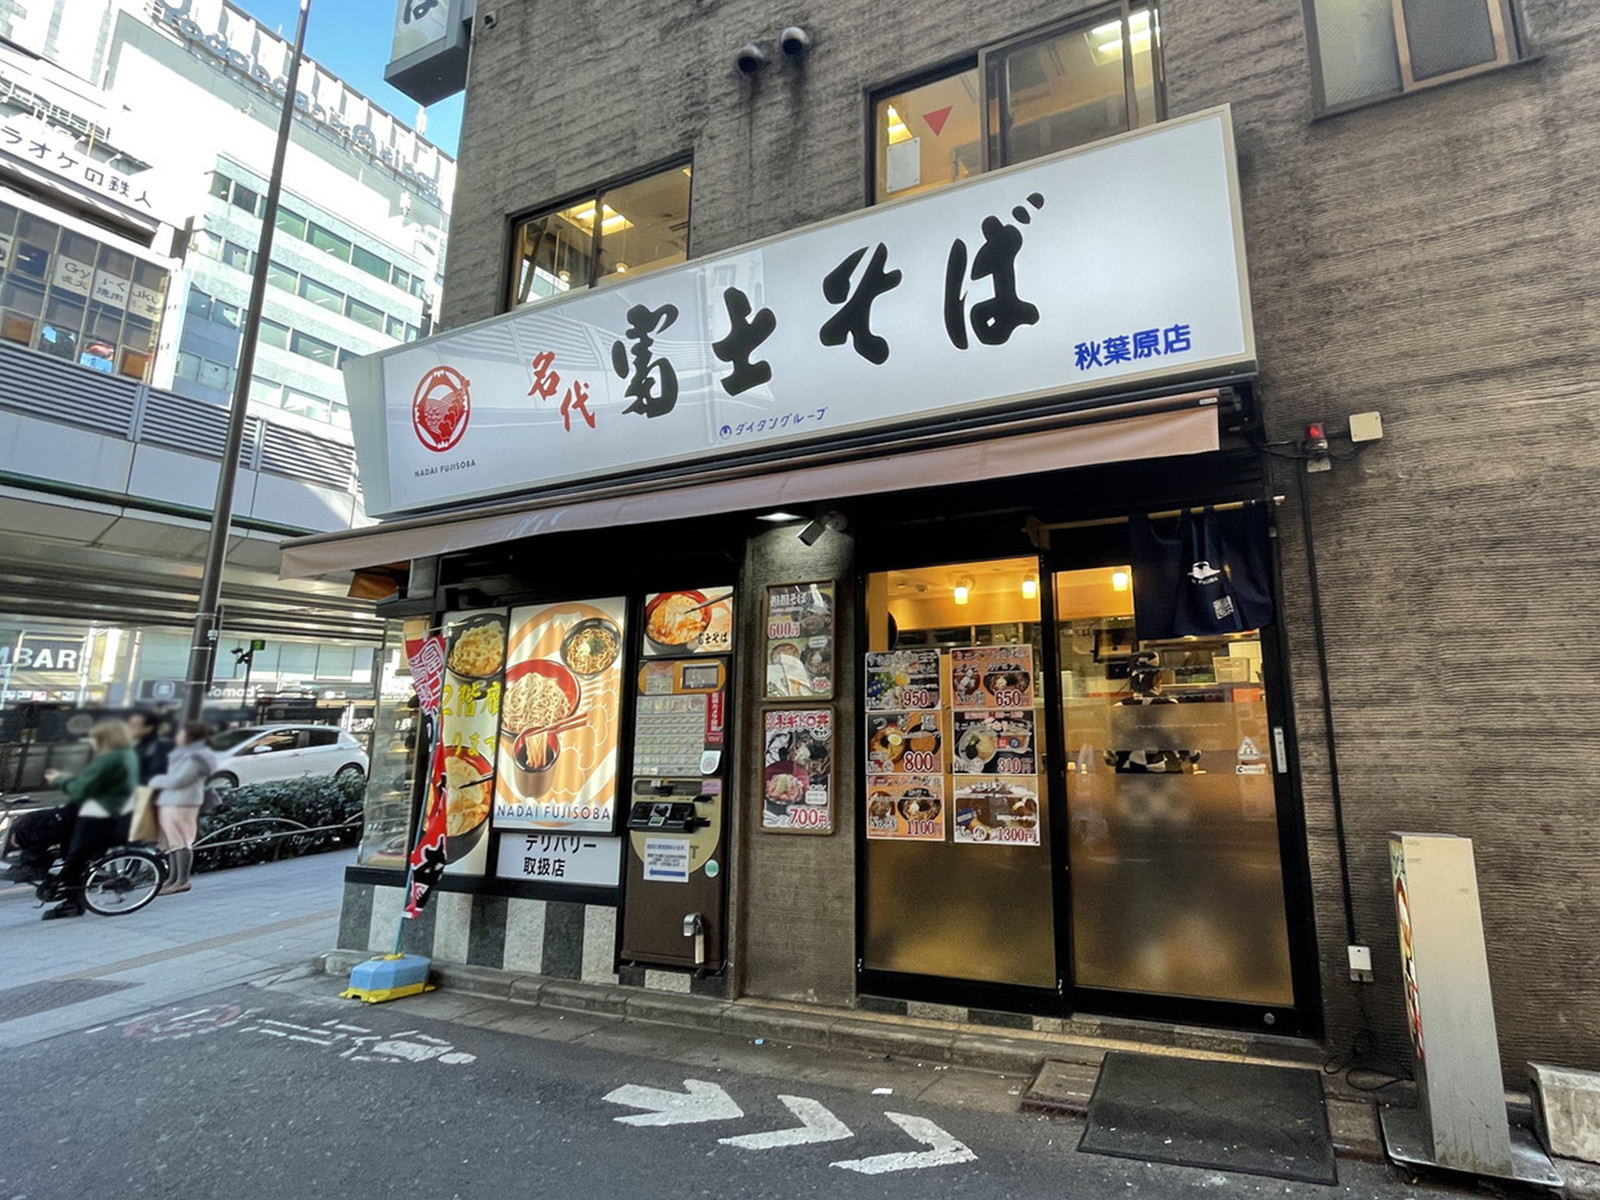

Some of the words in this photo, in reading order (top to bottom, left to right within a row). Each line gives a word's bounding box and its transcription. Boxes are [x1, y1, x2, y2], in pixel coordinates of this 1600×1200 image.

[1074, 324, 1191, 371] 秋葉原店
[527, 351, 596, 432] 名代
[736, 406, 828, 436] ダイタングループ
[414, 466, 438, 478] NADAI
[440, 459, 476, 473] FUJISOBA
[776, 713, 828, 728] ネギトロ丼
[497, 805, 539, 818] NADAI
[544, 806, 610, 820] FUJISOBA
[790, 808, 827, 826] 700円
[526, 835, 597, 854] デリバリー
[523, 857, 566, 878] 取扱店
